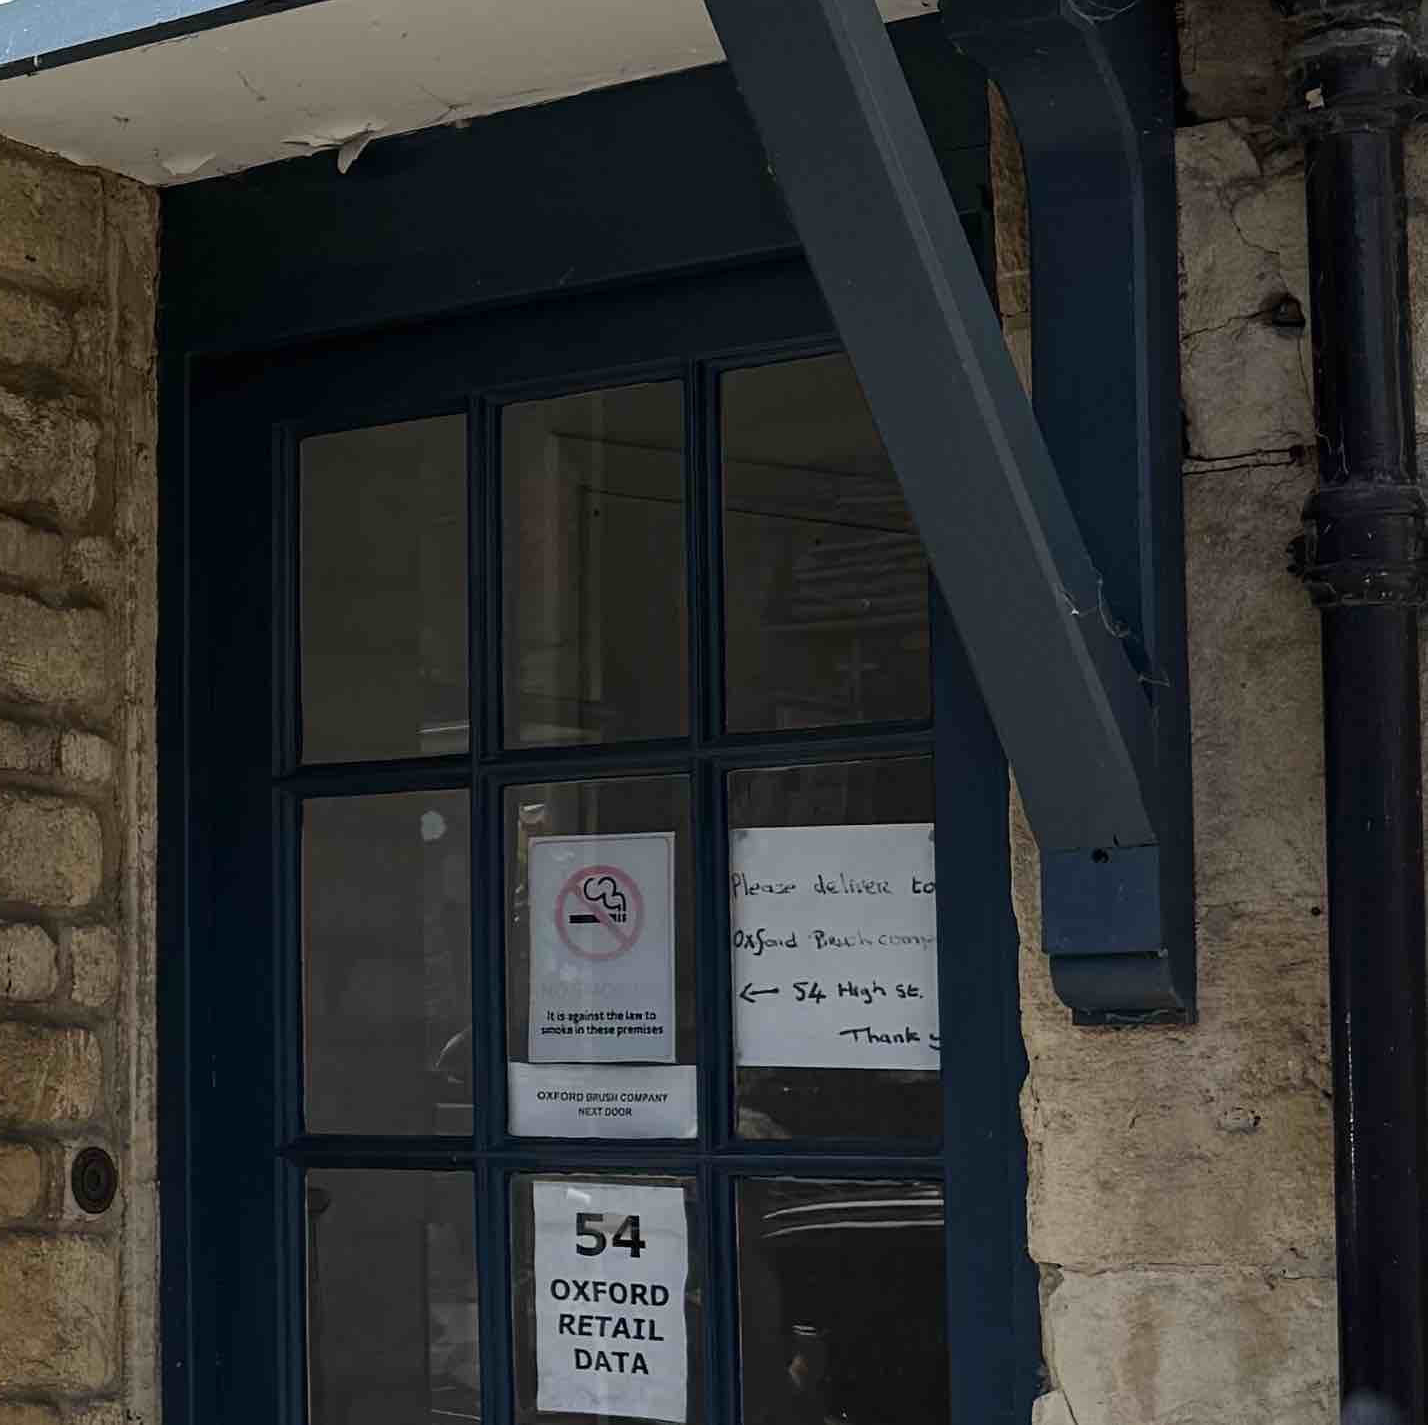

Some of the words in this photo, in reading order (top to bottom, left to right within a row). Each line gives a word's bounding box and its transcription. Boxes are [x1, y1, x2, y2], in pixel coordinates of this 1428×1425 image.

[730, 871, 797, 898] Please
[911, 876, 936, 894] to
[732, 928, 798, 956] Oxford
[793, 981, 827, 1004] 54
[838, 979, 887, 1004] High
[546, 1010, 555, 1022] It
[557, 1010, 565, 1022] is
[568, 1010, 604, 1024] against
[606, 1009, 624, 1021] the
[625, 1010, 643, 1021] law
[645, 1010, 657, 1021] to
[575, 1025, 585, 1035] in
[586, 1024, 616, 1035] these
[616, 1025, 664, 1038] premises
[839, 1026, 921, 1044] Thank
[536, 1091, 584, 1102] OXFORD
[619, 1092, 668, 1103] COMPANY
[577, 1107, 603, 1117] NEXT
[604, 1107, 633, 1117] DOOR
[575, 1212, 647, 1258] 54
[550, 1278, 670, 1306] OXFORD
[558, 1313, 665, 1342] RETAIL
[573, 1348, 649, 1375] DATA
